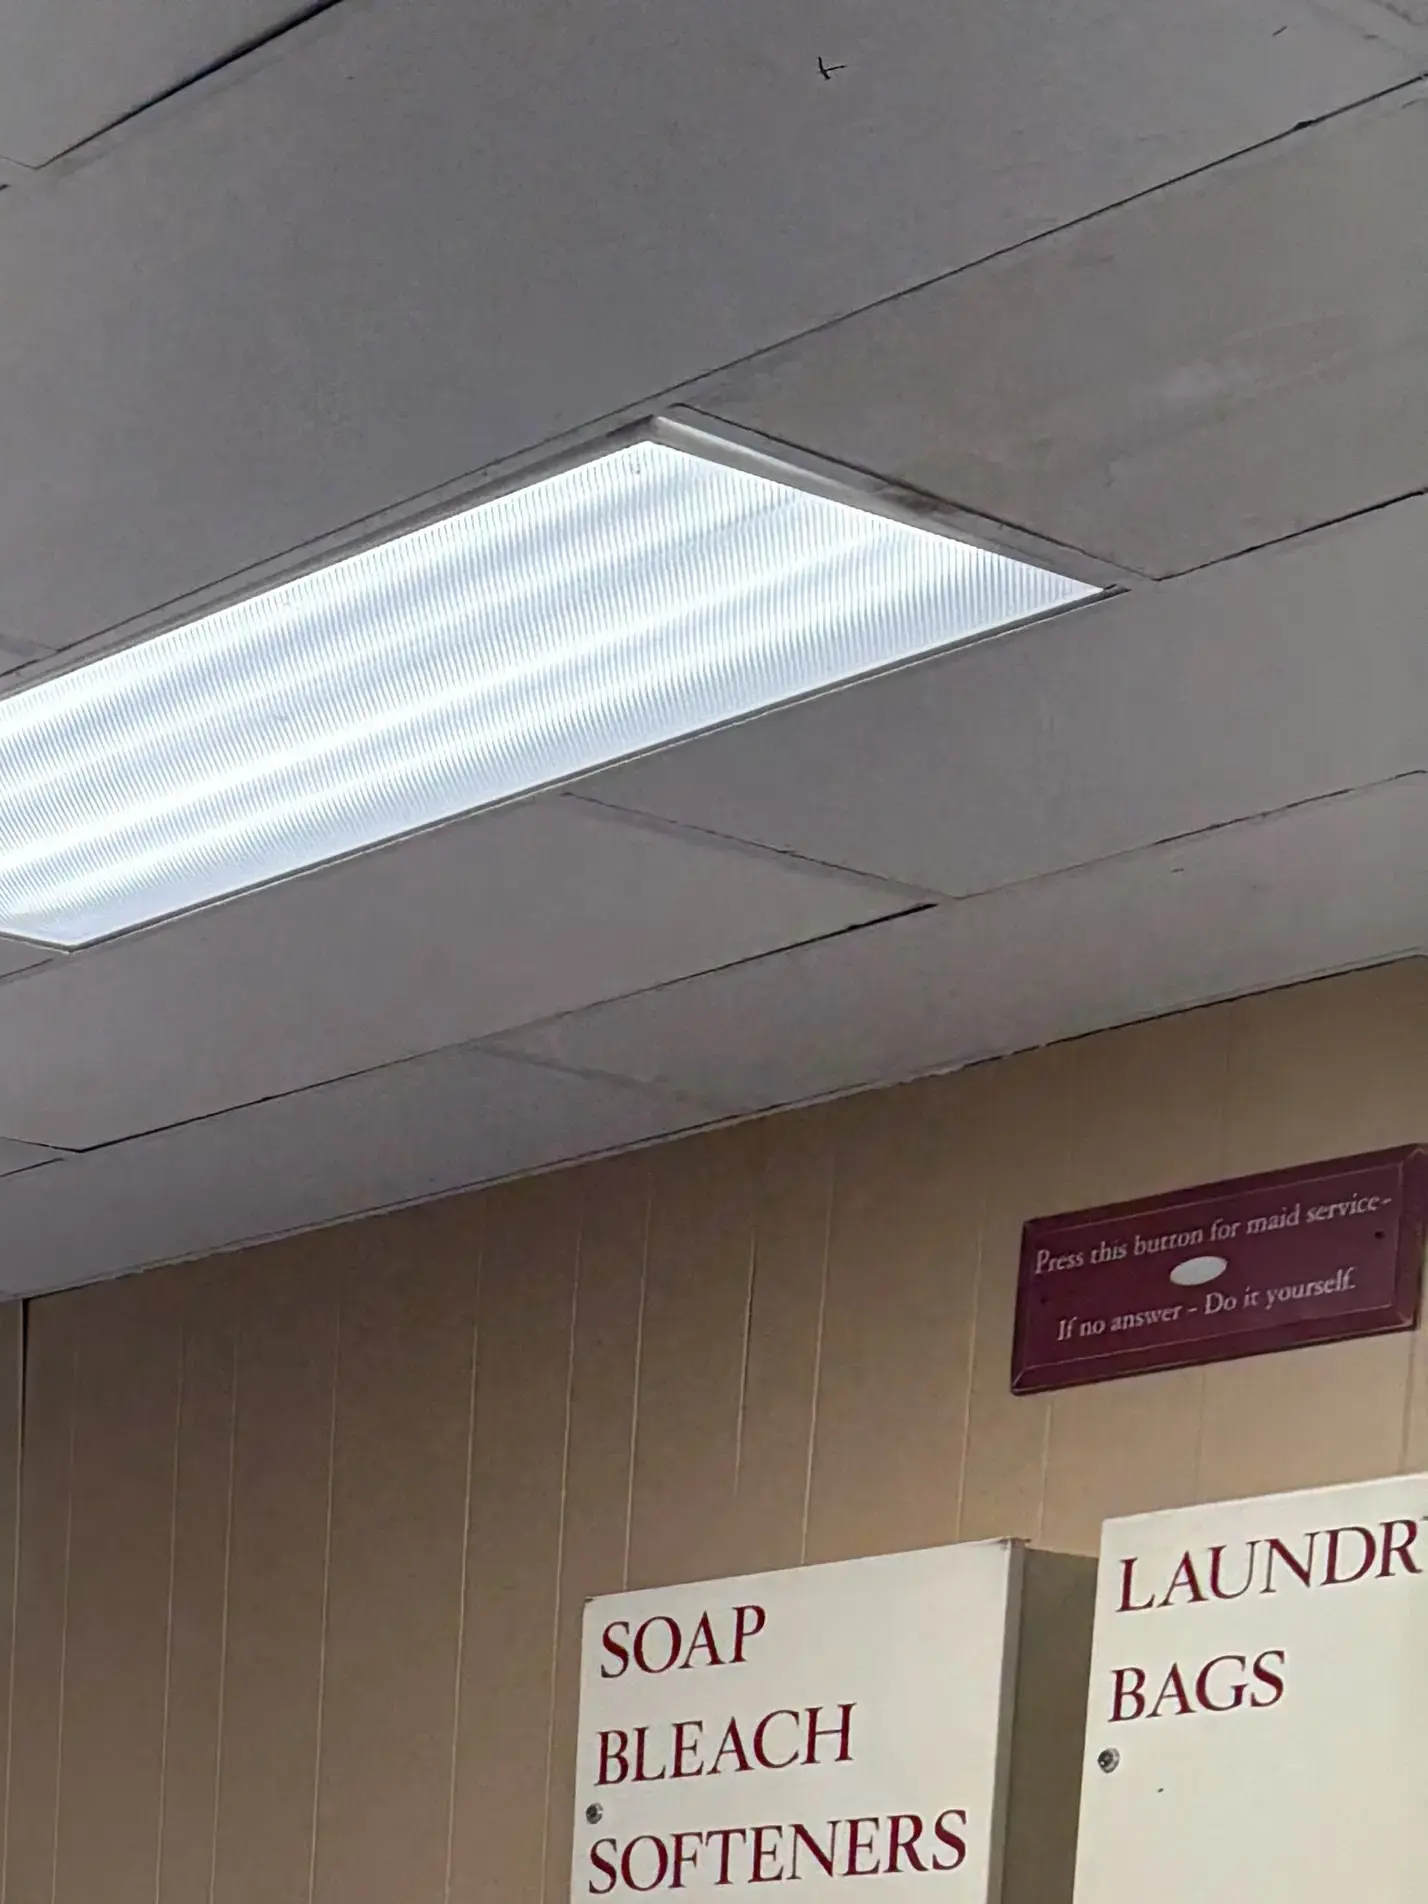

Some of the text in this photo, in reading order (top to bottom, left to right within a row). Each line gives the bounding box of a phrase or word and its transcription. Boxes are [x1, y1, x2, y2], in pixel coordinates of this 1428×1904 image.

[1034, 1249, 1085, 1275] Press
[1089, 1239, 1127, 1265] this
[1133, 1225, 1203, 1257] button
[1210, 1218, 1241, 1243] for
[1246, 1203, 1300, 1236] maid
[1056, 1316, 1078, 1342] If
[1079, 1318, 1106, 1337] no
[1110, 1305, 1183, 1334] answer
[1204, 1292, 1237, 1316] Do
[1244, 1286, 1259, 1308] it
[1264, 1266, 1357, 1310] yourself.
[1115, 1515, 1428, 1612] LAUNDR
[599, 1604, 766, 1679] SOAP
[1107, 1649, 1287, 1723] BAGS
[594, 1702, 858, 1787] BLEACH
[587, 1808, 968, 1895] SOFTENERS
